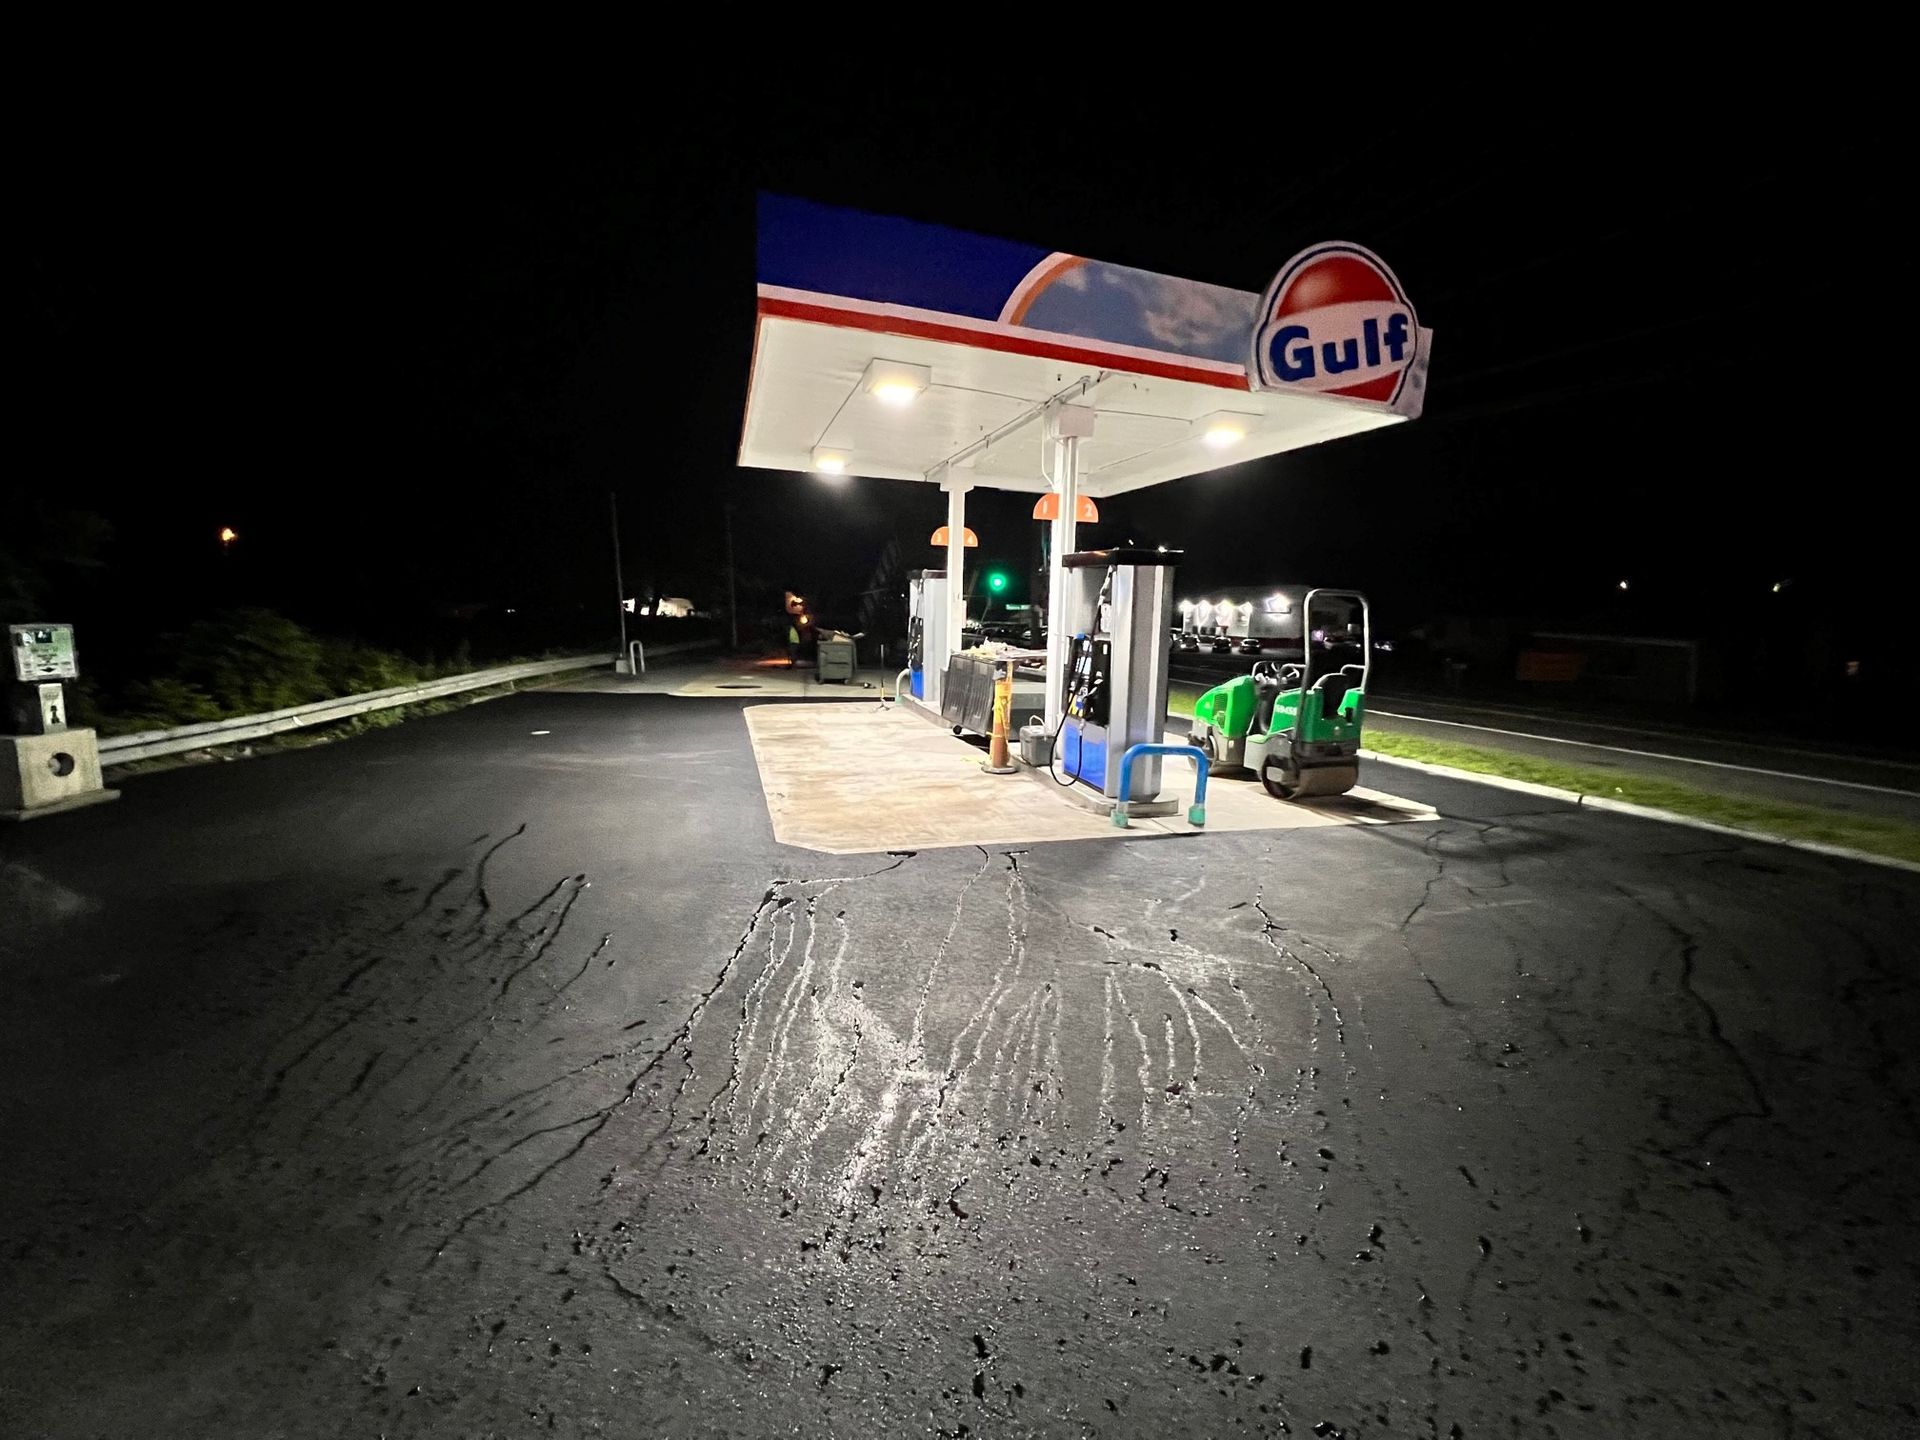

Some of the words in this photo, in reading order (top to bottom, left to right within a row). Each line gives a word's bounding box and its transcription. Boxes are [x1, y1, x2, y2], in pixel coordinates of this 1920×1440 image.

[1269, 313, 1409, 382] Gulf
[1042, 500, 1048, 515] 1
[1084, 503, 1093, 517] 2
